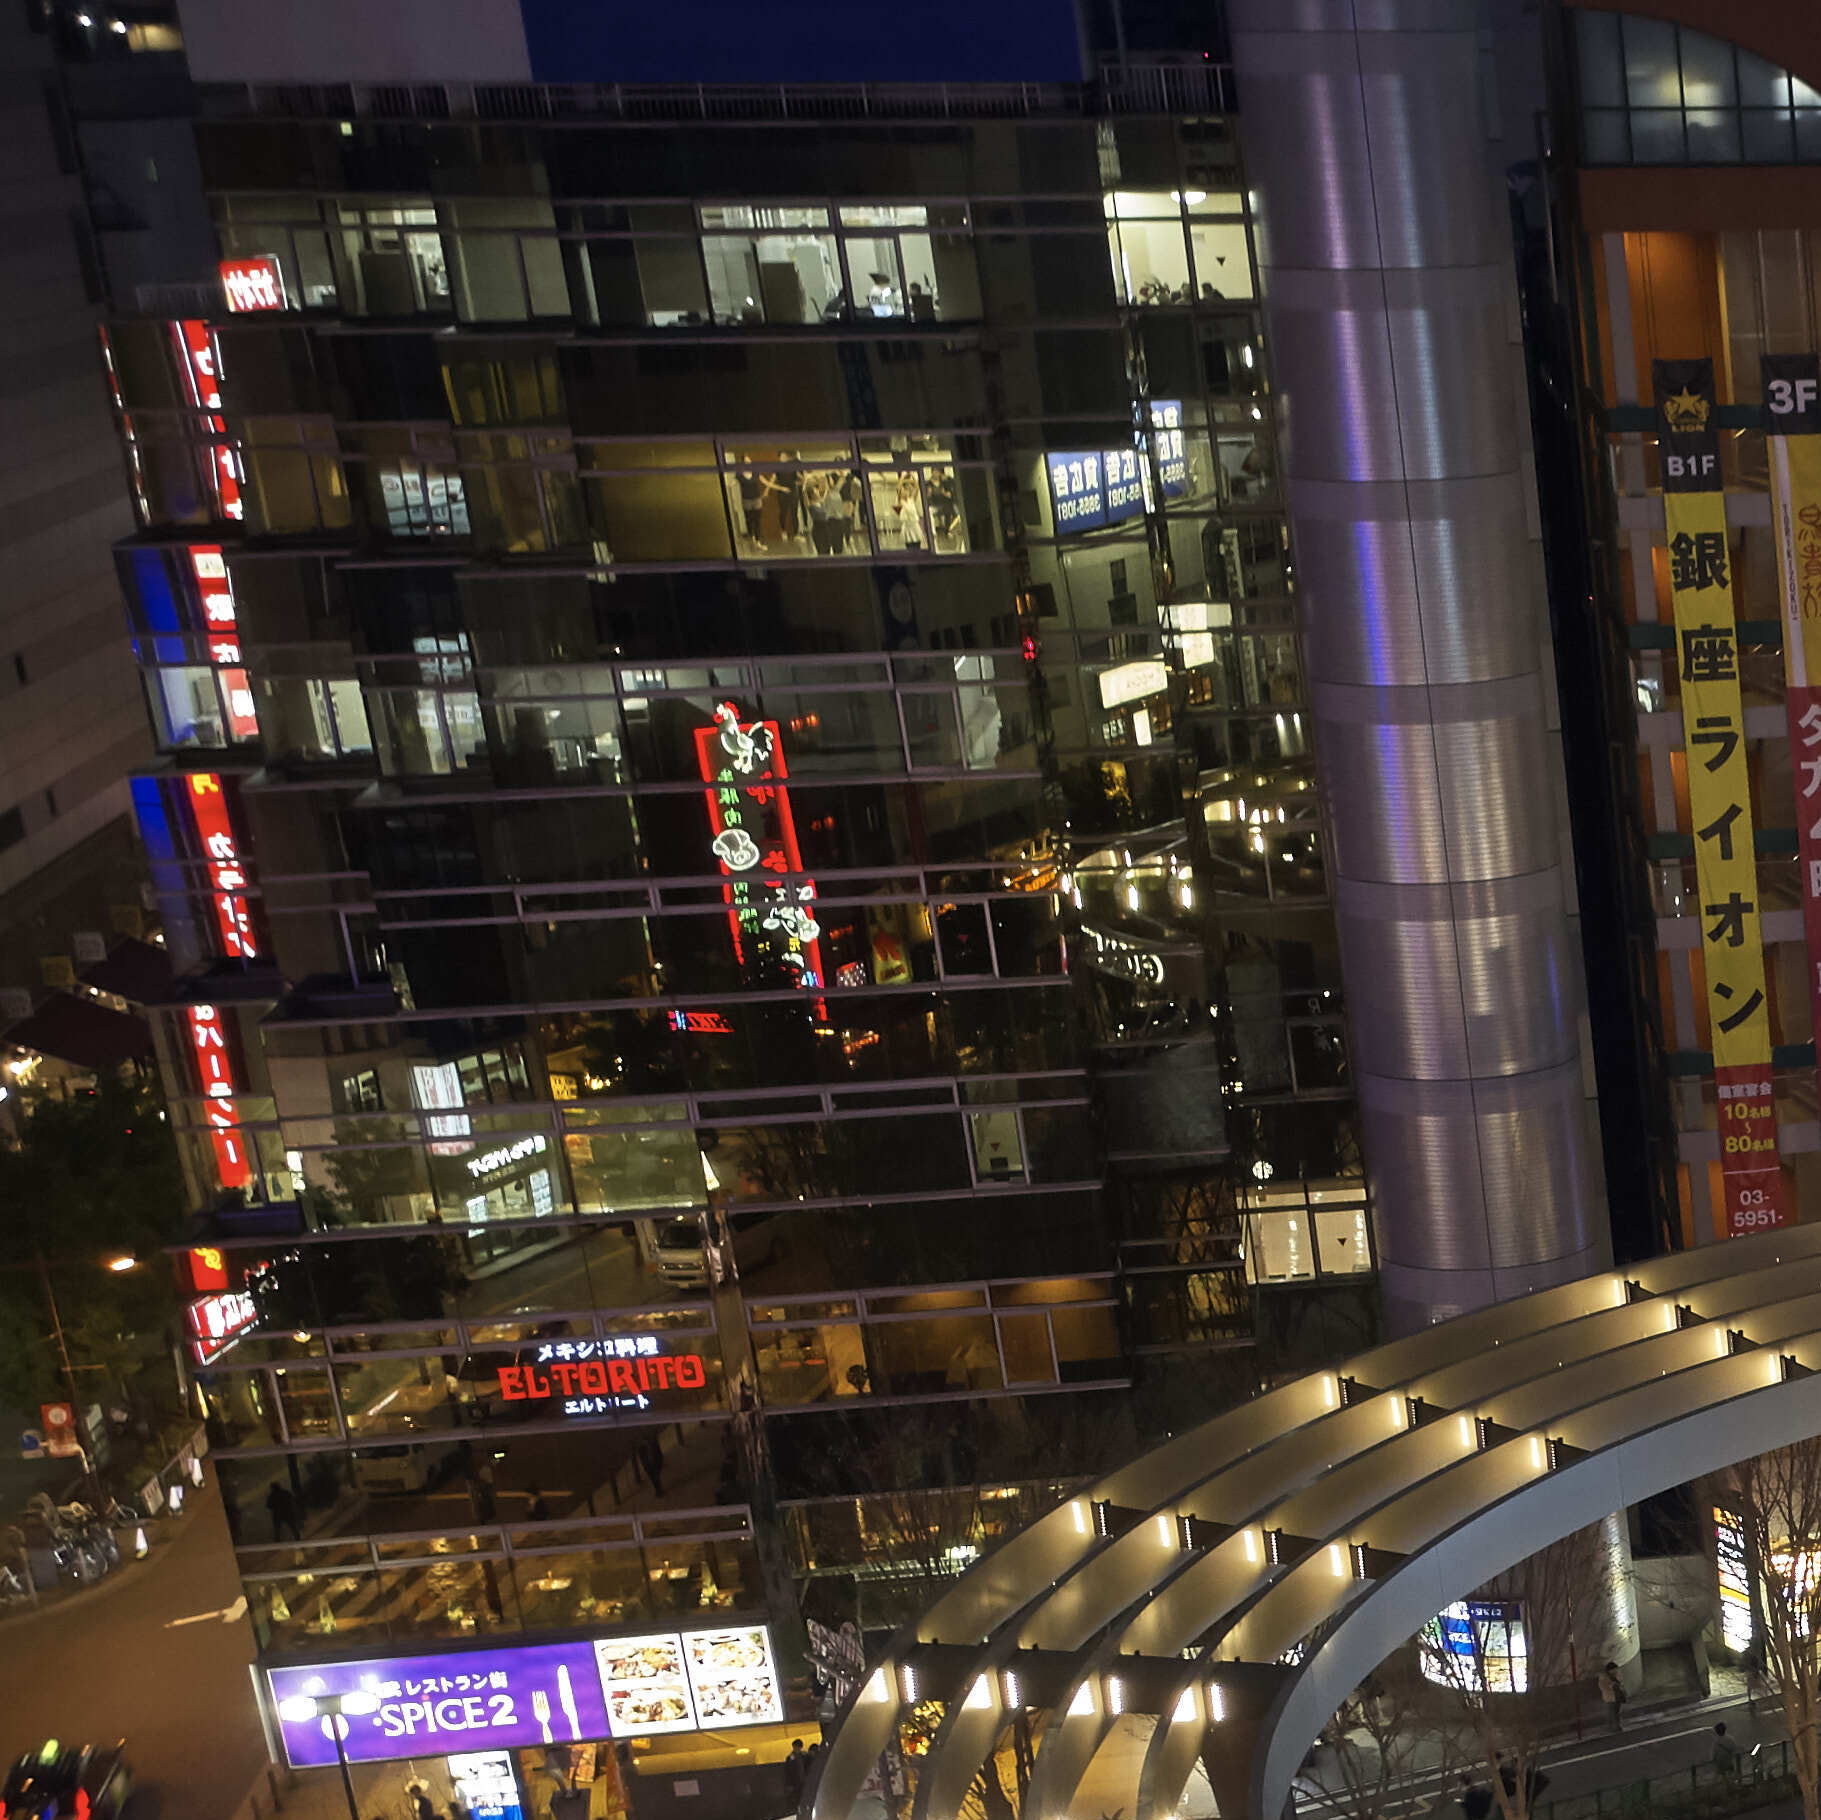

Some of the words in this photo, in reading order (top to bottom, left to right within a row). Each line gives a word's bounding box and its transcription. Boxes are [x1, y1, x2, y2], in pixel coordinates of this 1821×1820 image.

[1768, 379, 1817, 414] 3F
[1667, 455, 1715, 477] B1F
[1670, 531, 1764, 1035] 銀座ライオン
[1724, 1103, 1772, 1120] 10名様
[1725, 1136, 1775, 1153] 80名様
[1739, 1189, 1771, 1205] 03-
[1734, 1209, 1784, 1228] 5951-
[497, 1366, 551, 1401] EL
[551, 1354, 706, 1397] TORITO
[380, 1694, 518, 1737] SPICE2
